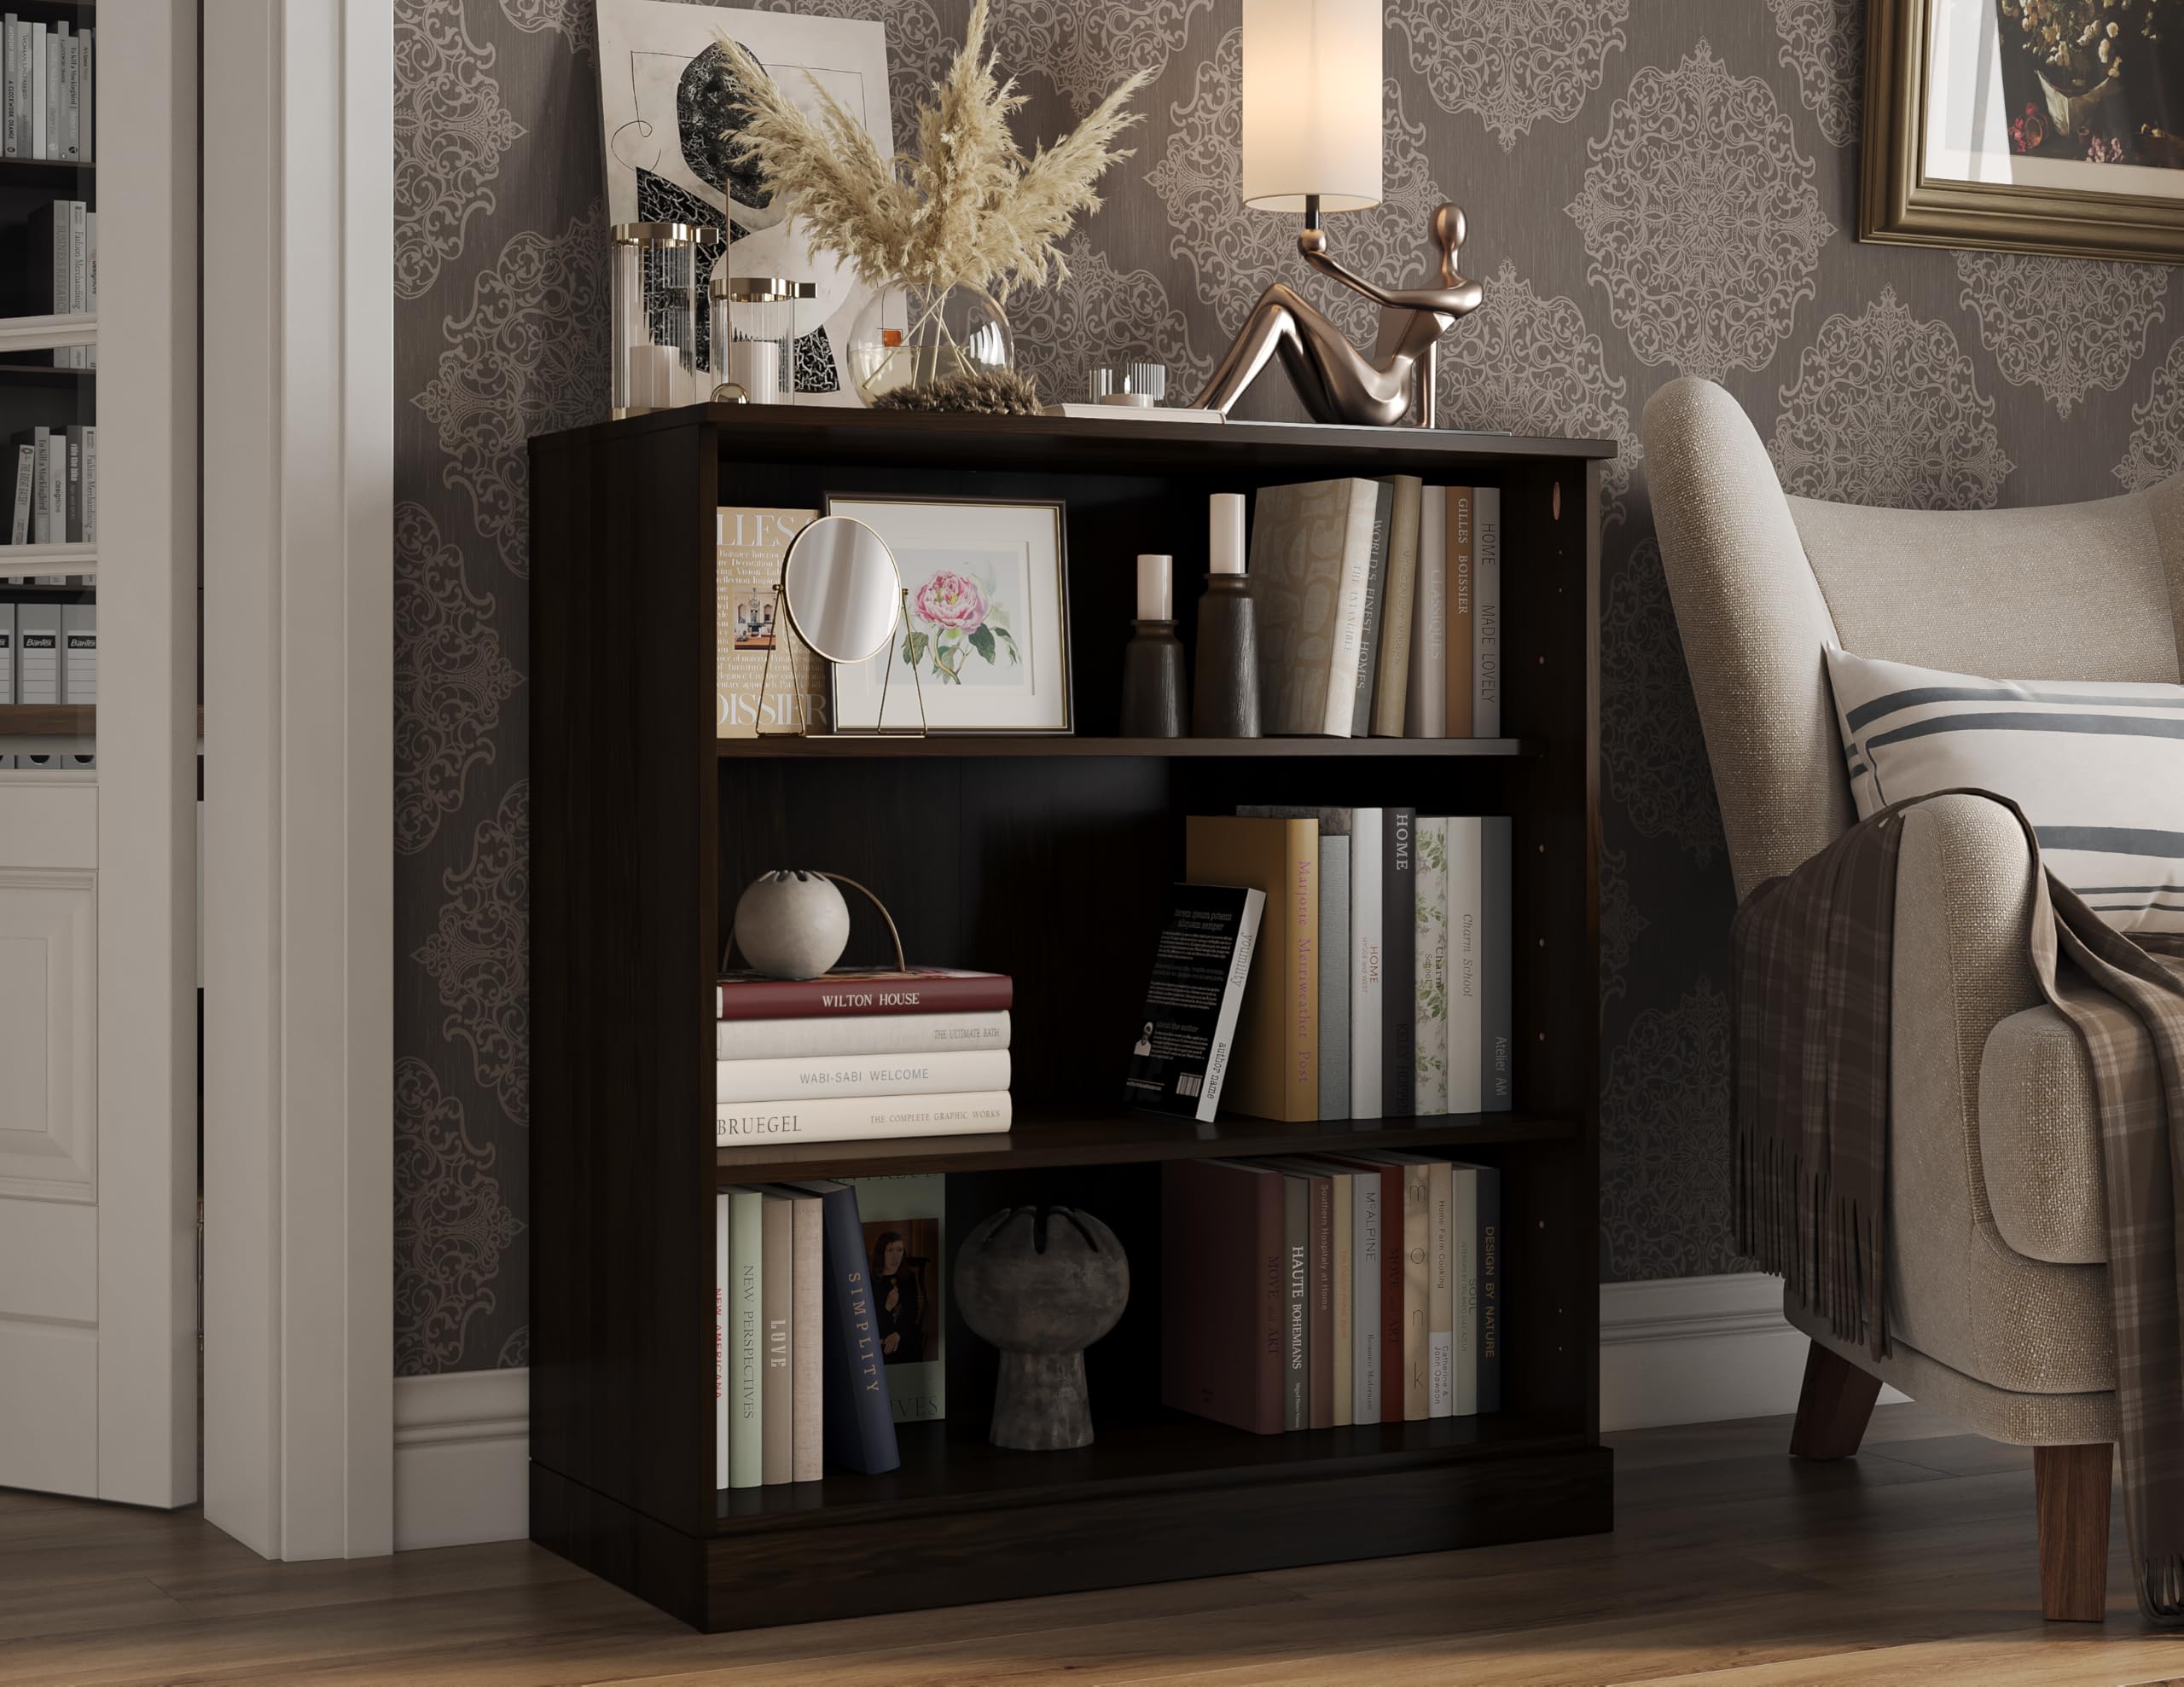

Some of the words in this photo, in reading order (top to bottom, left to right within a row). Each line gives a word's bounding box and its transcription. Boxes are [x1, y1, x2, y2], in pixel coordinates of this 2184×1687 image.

[69, 70, 78, 105] Mockingbird
[56, 225, 66, 266] BUSINESS
[74, 231, 84, 258] Fashion
[56, 269, 66, 314] RESEARCH
[72, 259, 84, 310] Merchandising
[70, 443, 78, 455] ride
[70, 457, 78, 467] the
[86, 455, 96, 479] Fashion
[38, 468, 47, 510] Mockingbird
[70, 468, 78, 482] bike
[84, 481, 96, 529] Merchandising
[1458, 498, 1468, 544] GILLES
[1368, 519, 1383, 581] WORLD'S
[1482, 523, 1496, 565] HOME
[1350, 565, 1361, 585] THE
[1458, 555, 1468, 615] BOISSIER
[1363, 587, 1375, 635] FINEST
[1482, 605, 1496, 646] MADE
[26, 638, 52, 647] Bantex
[1356, 641, 1369, 689] HOMES
[1482, 653, 1496, 704] LOVELY
[1397, 814, 1409, 871] HOME
[1297, 860, 1311, 926] Marjorie
[1463, 913, 1473, 952] Charm
[1369, 947, 1379, 983] HOME
[1435, 947, 1443, 988] Charm
[1463, 959, 1473, 998] School
[822, 994, 873, 1007] WILTON
[879, 992, 921, 1006] HOUSE
[1298, 938, 1311, 1038] Merriweather
[934, 1029, 947, 1040] THE
[950, 1029, 980, 1040] ULTIMATE
[983, 1028, 1000, 1038] BATH
[1496, 1036, 1507, 1072] Atelier
[800, 1071, 862, 1084] WABI-SABI
[870, 1068, 929, 1081] WELCOME
[1212, 1042, 1227, 1074] author
[1298, 1050, 1311, 1084] Post
[1206, 1073, 1219, 1099] name
[1496, 1077, 1507, 1096] AM
[717, 1116, 802, 1135] BRUEGEL
[870, 1116, 887, 1124] THE
[889, 1113, 930, 1123] COMPLETE
[934, 1111, 967, 1121] GRAPHIC
[973, 1110, 1000, 1119] WORKS
[1321, 1185, 1329, 1226] Southern
[1320, 1228, 1329, 1269] Hospitaly
[1485, 1226, 1495, 1275] DESIGN
[744, 1266, 754, 1302] NEW
[1269, 1255, 1280, 1296] MOVE
[1292, 1246, 1304, 1298] HAUTE
[1321, 1273, 1328, 1282] at
[1437, 1254, 1445, 1289] Cooking
[1485, 1282, 1495, 1297] BY
[1321, 1284, 1329, 1311] Home
[1468, 1278, 1478, 1315] SOUL
[770, 1319, 787, 1367] LOVE
[848, 1272, 880, 1392] SIMPLITY
[1269, 1327, 1280, 1354] ART
[1292, 1304, 1302, 1370] BOHEMIANS
[1485, 1307, 1495, 1359] NATURE
[743, 1311, 754, 1419] PERSPECTIVES
